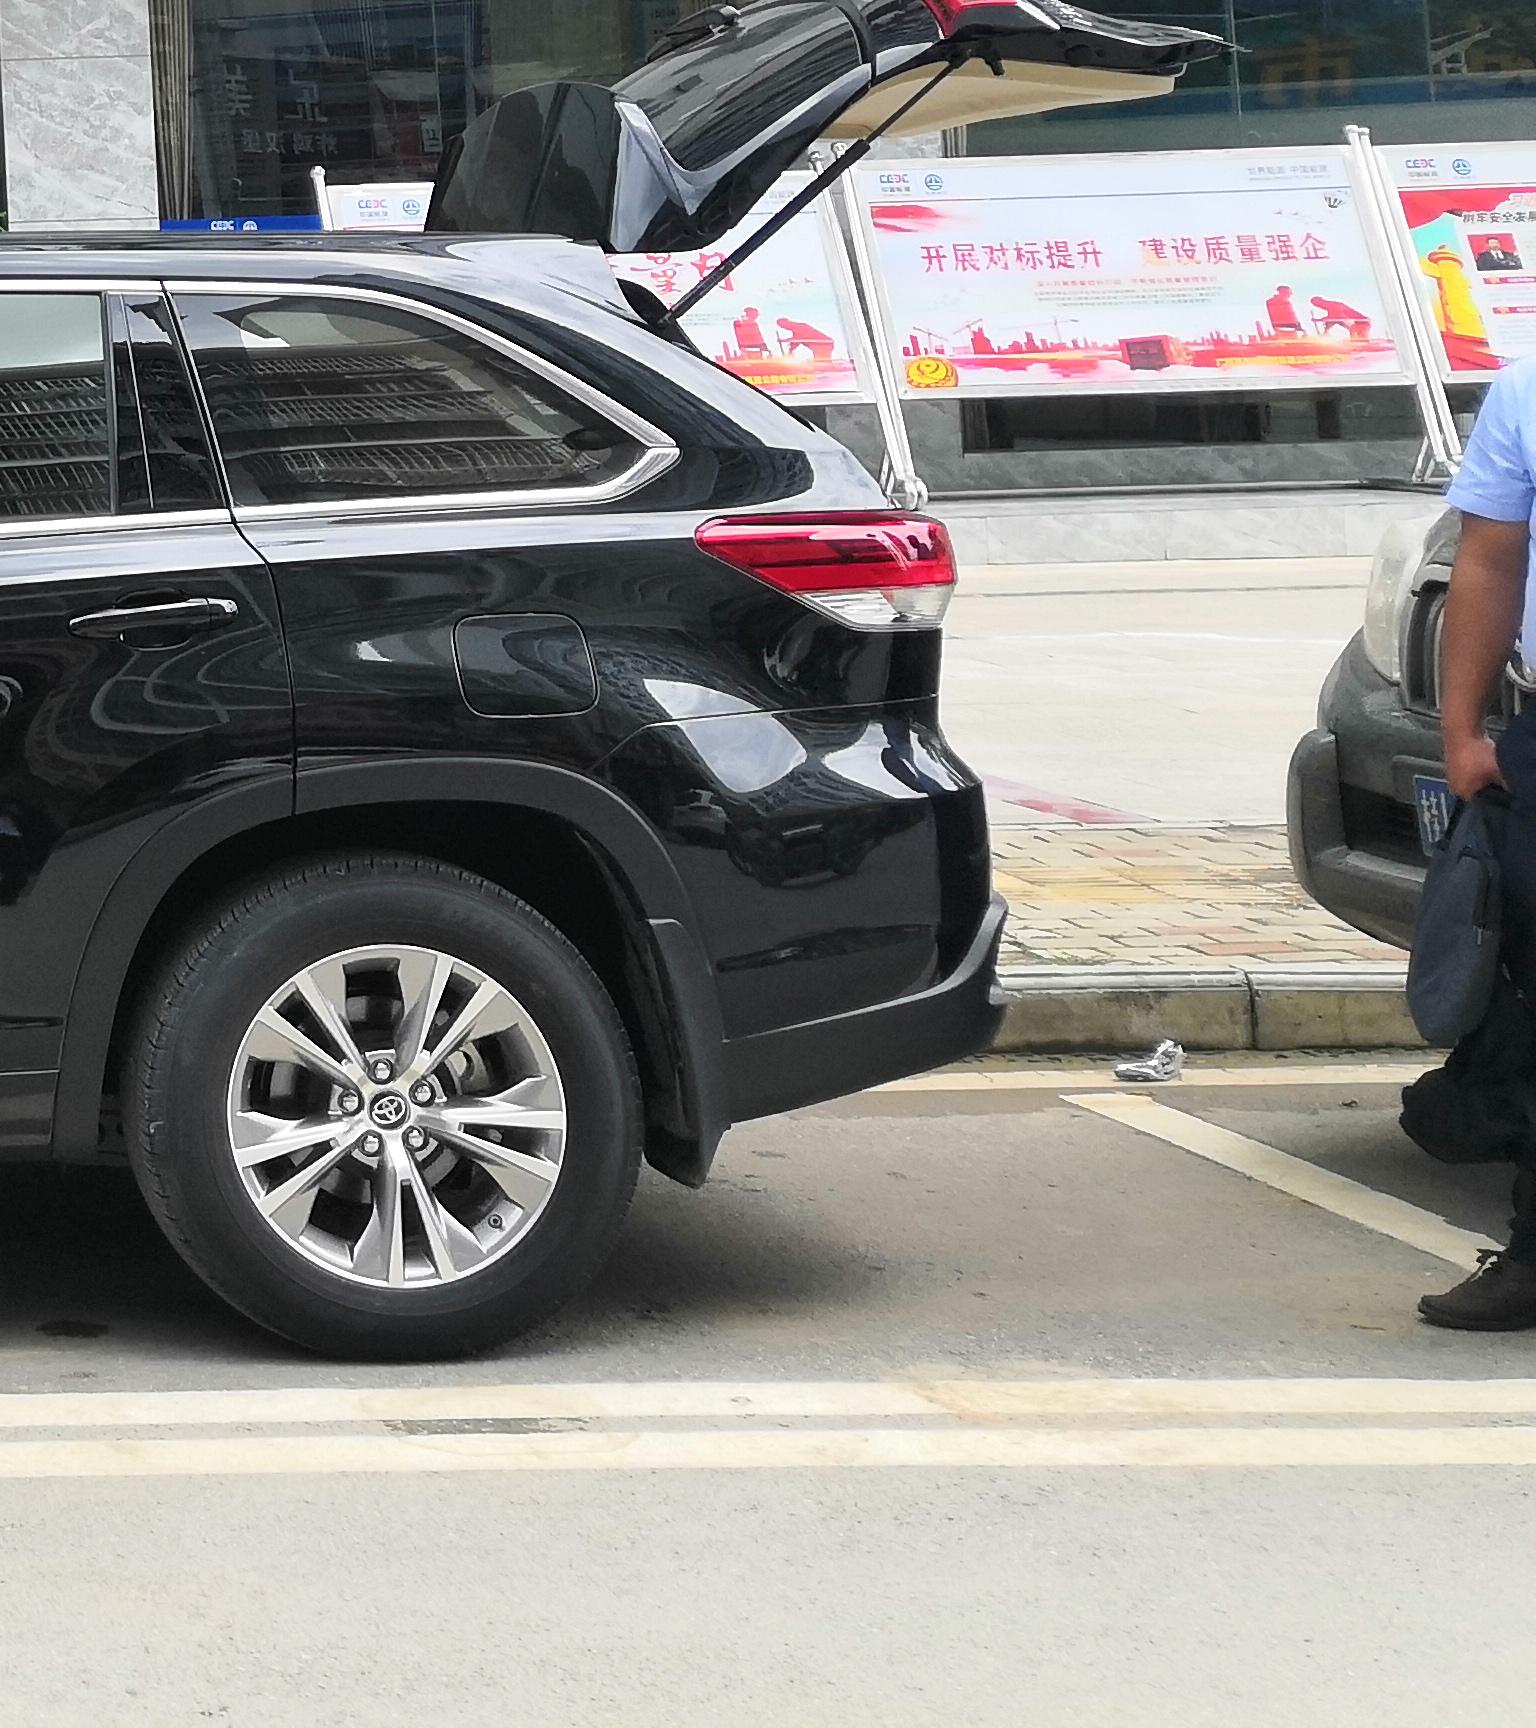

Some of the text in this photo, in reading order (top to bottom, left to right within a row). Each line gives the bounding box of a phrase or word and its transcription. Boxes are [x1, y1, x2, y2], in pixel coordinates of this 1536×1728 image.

[920, 233, 1330, 273] 开展对标提升 建设质量强企
